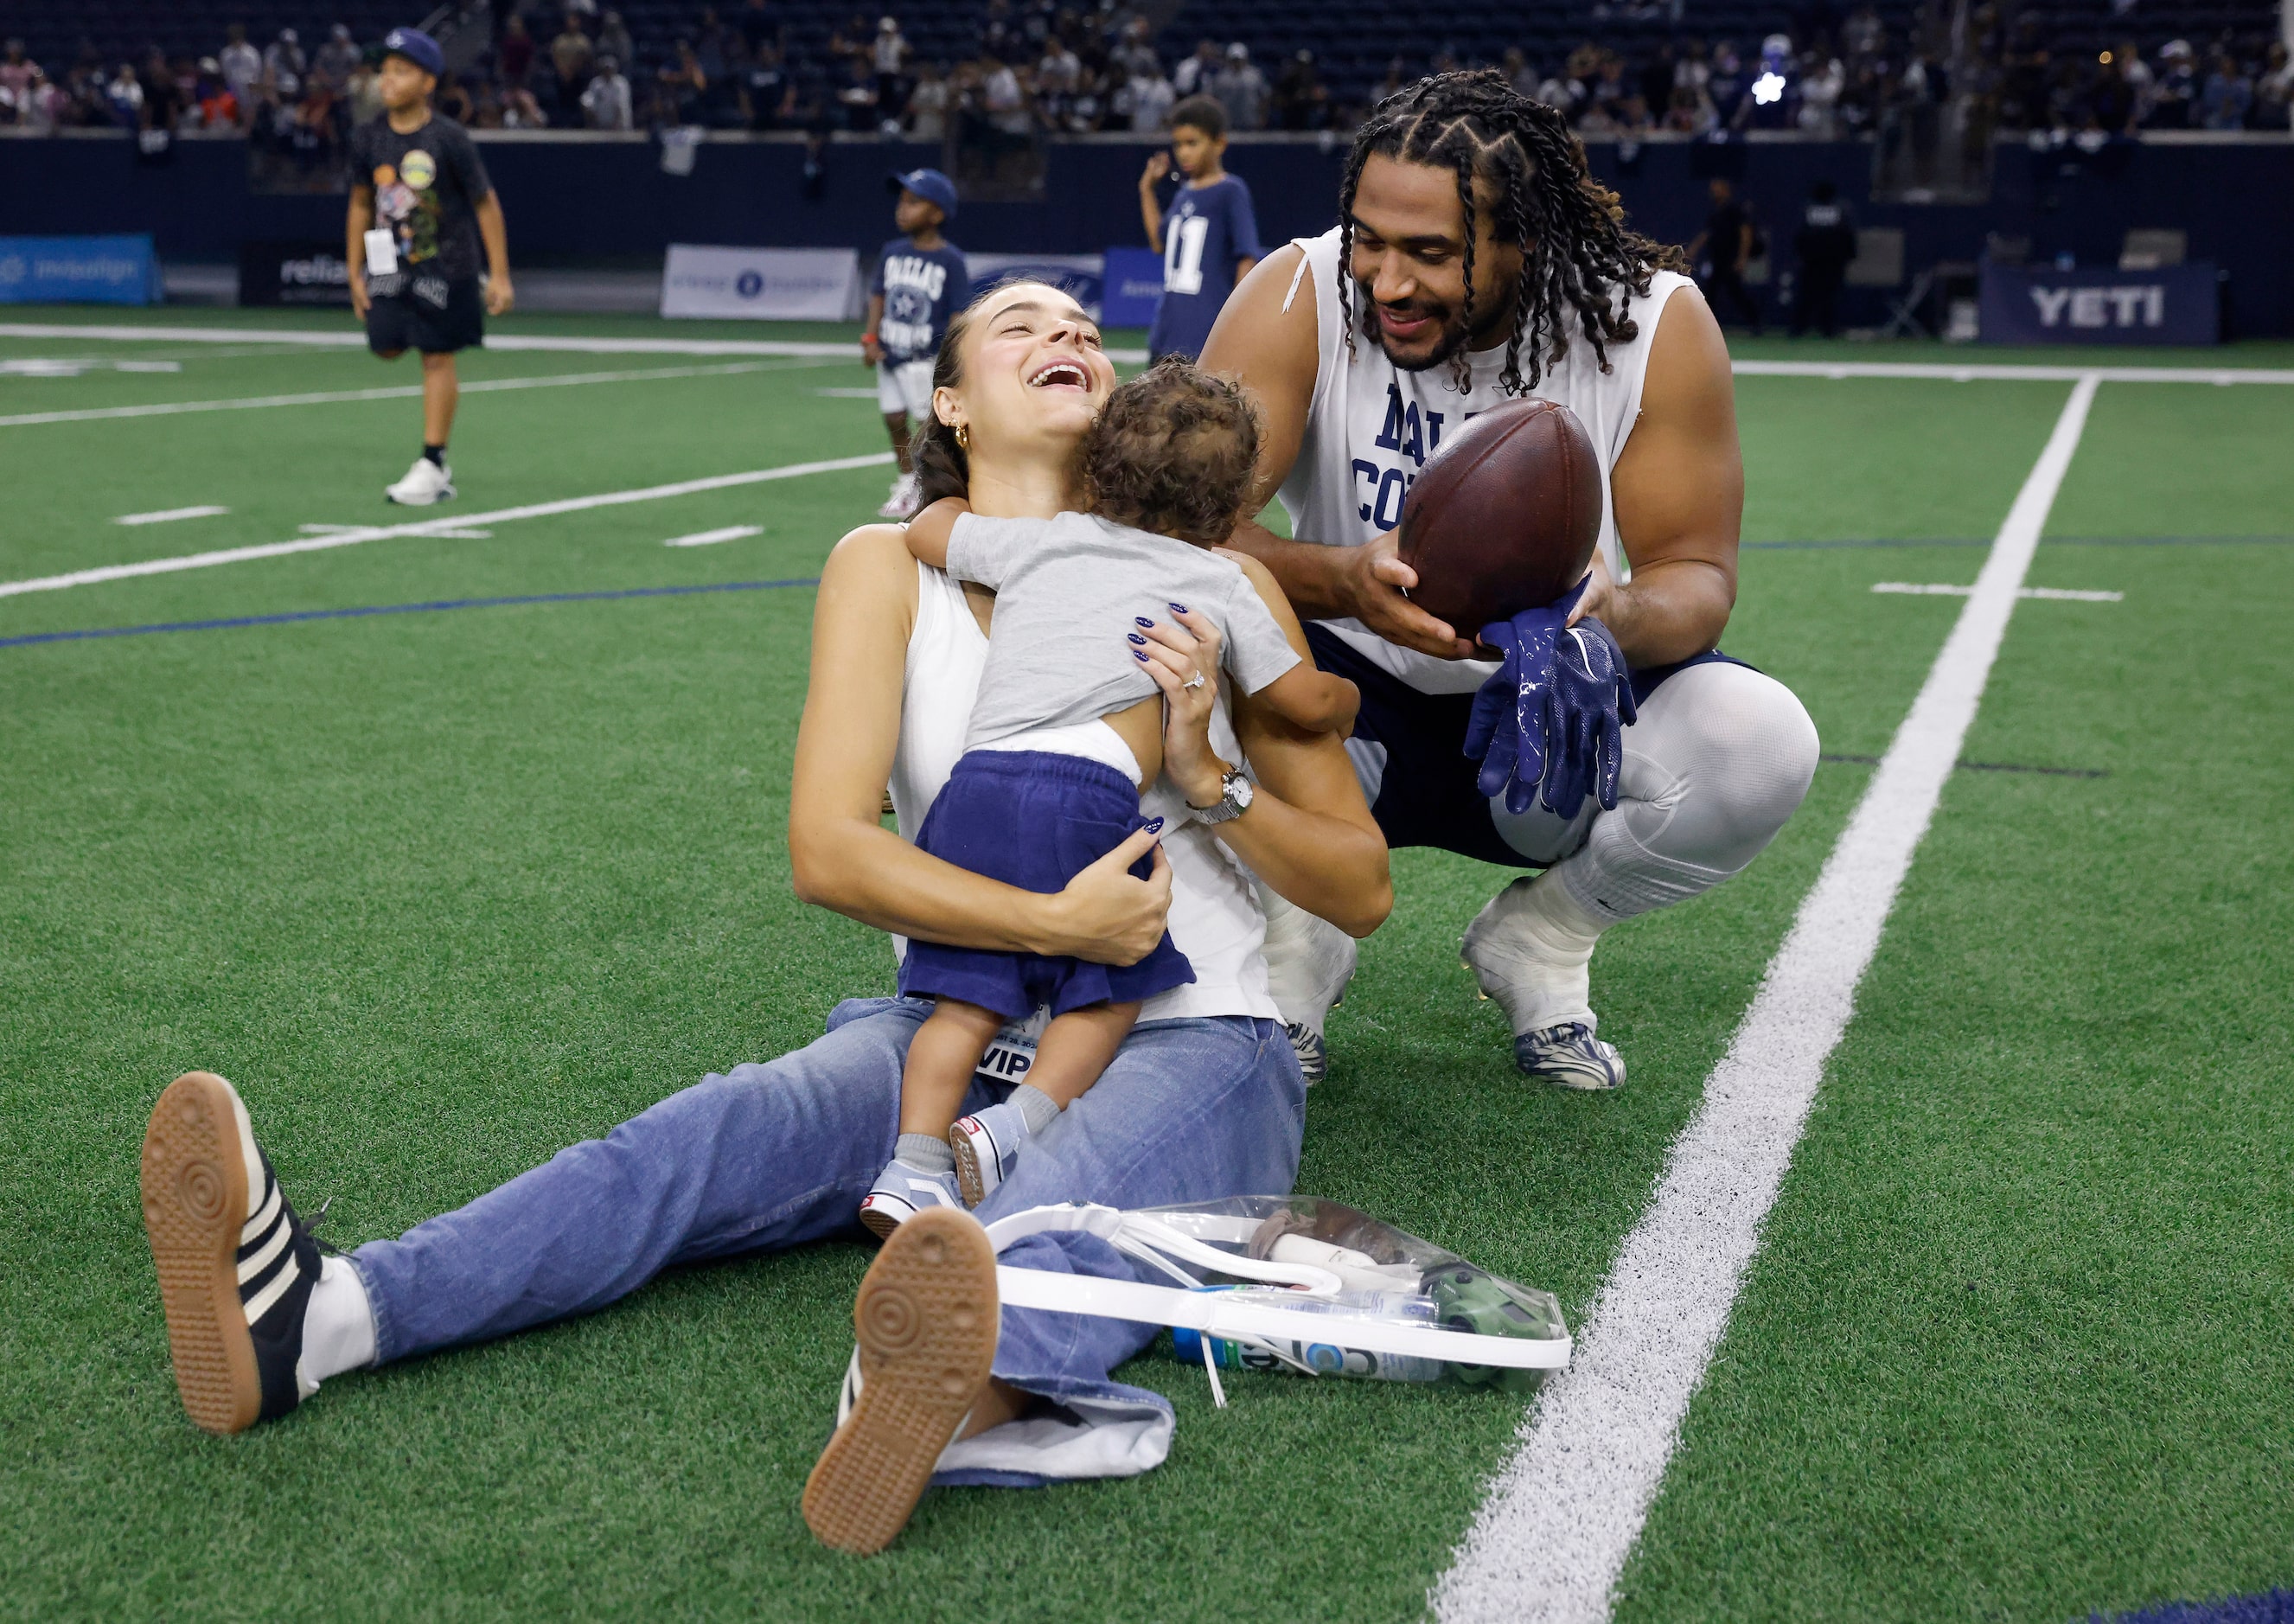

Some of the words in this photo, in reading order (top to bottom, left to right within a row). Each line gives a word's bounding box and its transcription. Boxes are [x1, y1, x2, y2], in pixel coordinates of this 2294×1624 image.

[280, 253, 349, 285] relia
[1164, 214, 1209, 295] 11
[2030, 285, 2164, 327] YETI
[1375, 383, 1479, 468] DAL
[1351, 458, 1415, 532] CO
[979, 1047, 1031, 1076] VIP
